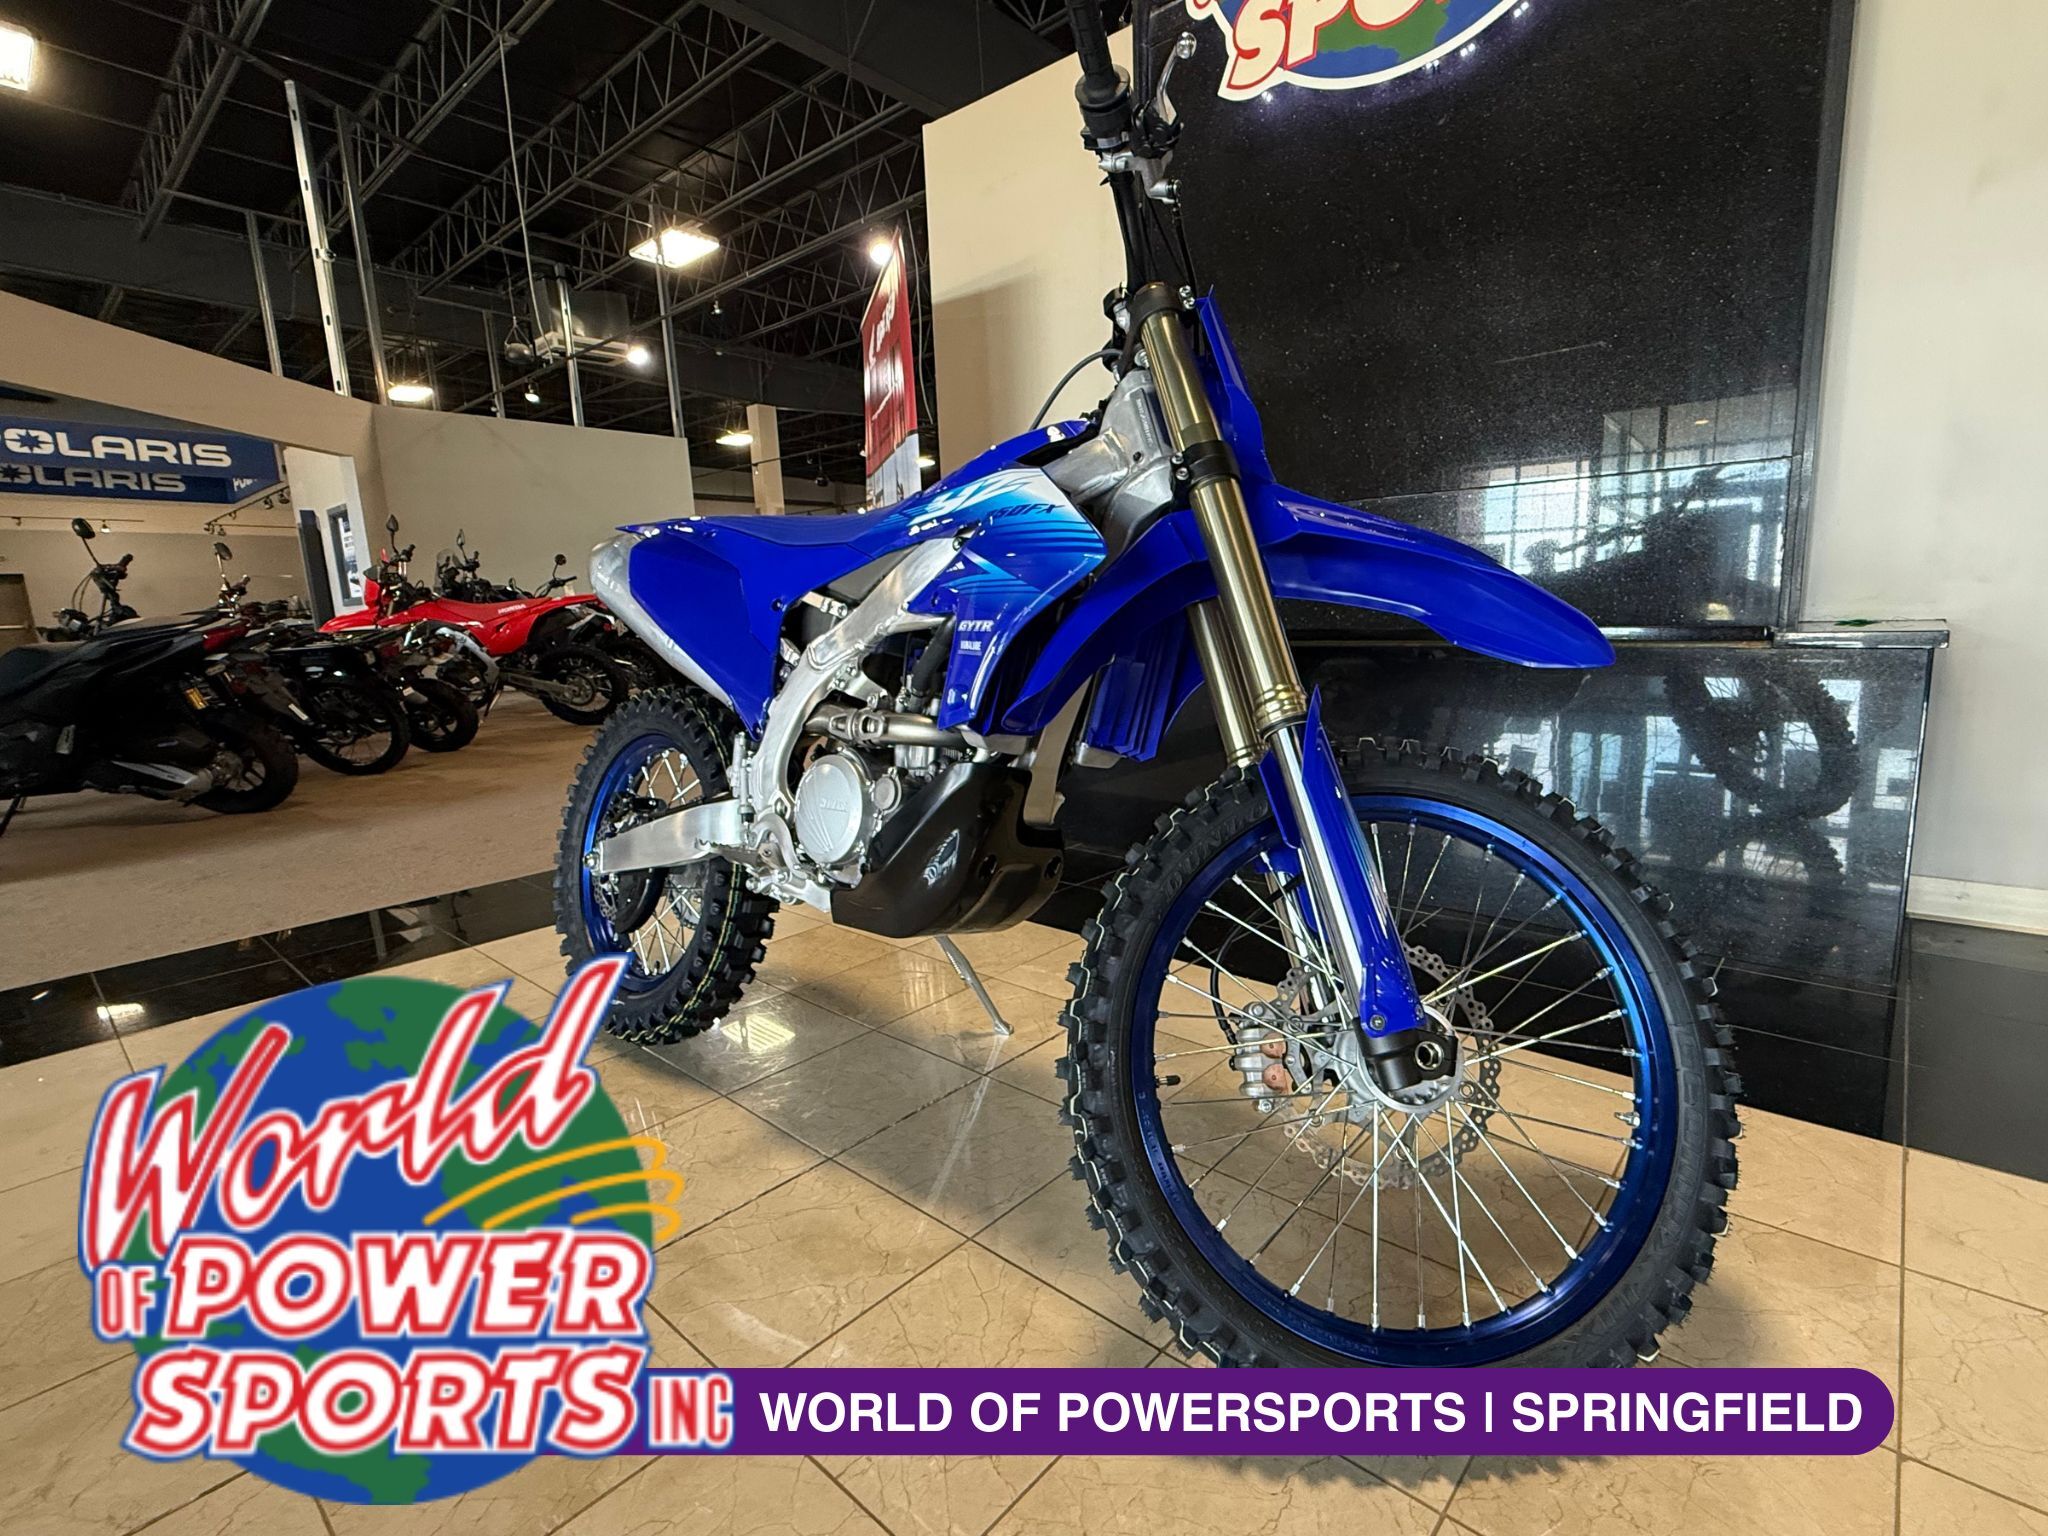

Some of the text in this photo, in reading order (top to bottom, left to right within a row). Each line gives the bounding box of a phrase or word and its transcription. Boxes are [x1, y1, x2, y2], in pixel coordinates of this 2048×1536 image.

[0, 428, 232, 467] OLARIS
[0, 463, 186, 493] OLARIS
[957, 619, 995, 632] GYTR
[1160, 800, 1270, 900] DUNLO
